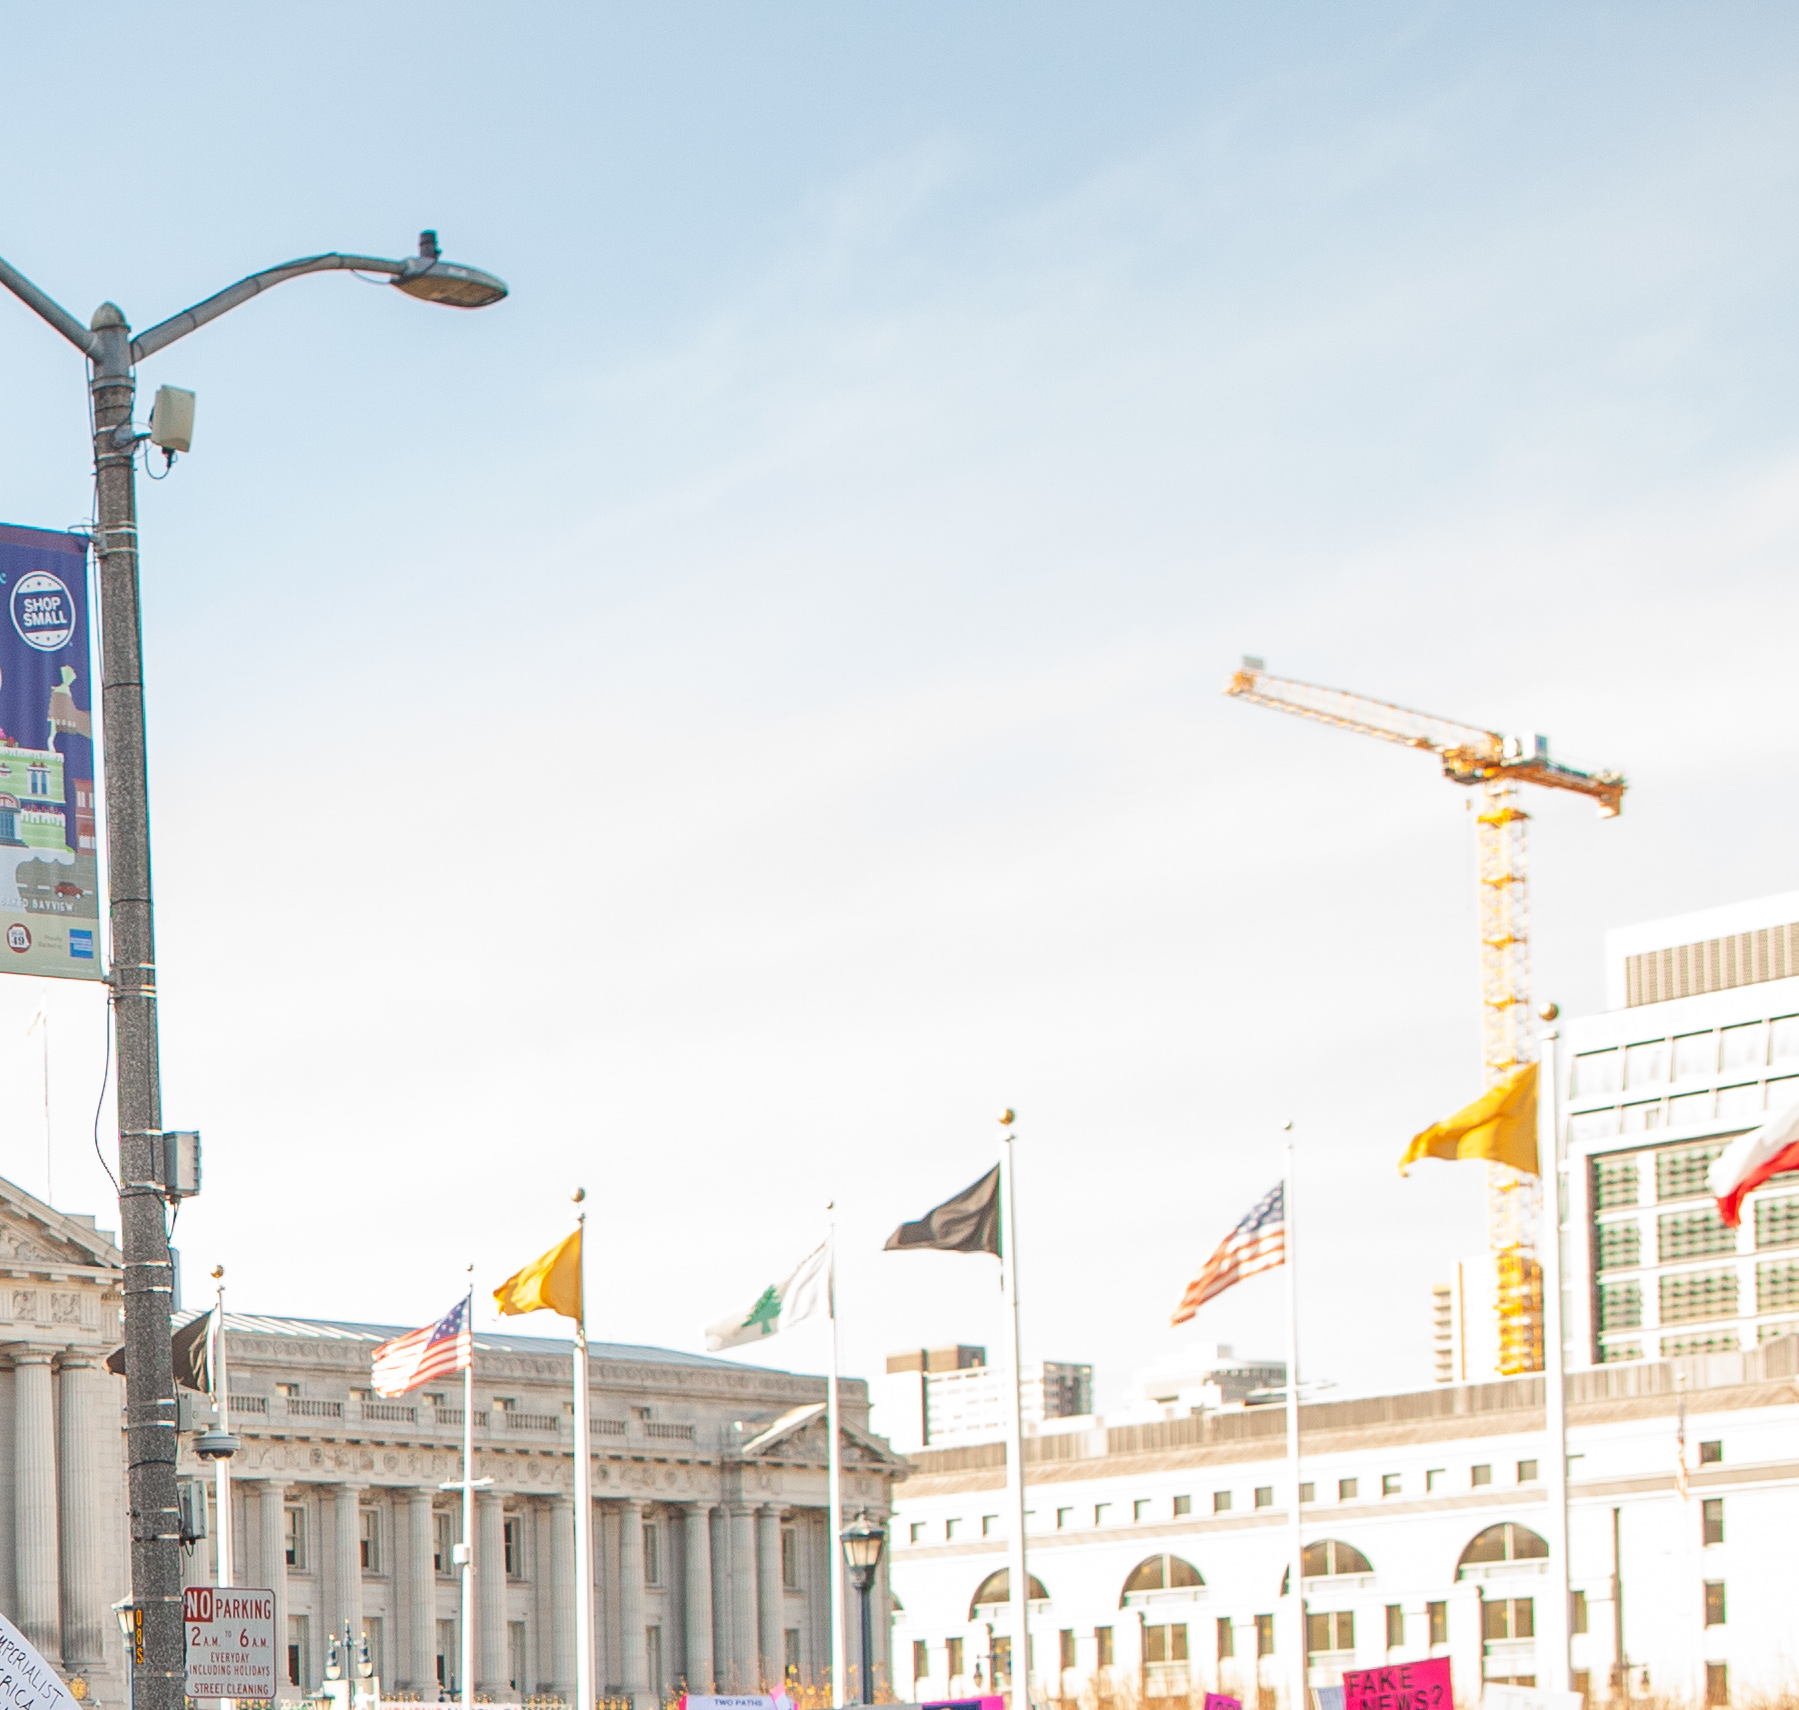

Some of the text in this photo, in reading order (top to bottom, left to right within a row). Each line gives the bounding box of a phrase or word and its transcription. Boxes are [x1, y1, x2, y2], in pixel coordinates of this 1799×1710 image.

[23, 596, 61, 613] SHOP
[23, 611, 68, 627] SMALL
[33, 899, 73, 912] BAYVIEW
[186, 1590, 271, 1620] NO PARKING
[191, 1626, 201, 1646] 2
[203, 1637, 221, 1647] A.M.
[239, 1628, 249, 1647] 6
[252, 1638, 269, 1648] A.M.
[210, 1652, 250, 1663] EVERYDAY
[189, 1664, 270, 1677] INCLUDING HOLIDAYS
[1348, 1666, 1415, 1697] FAKE
[194, 1683, 269, 1695] STREET CLEANING
[735, 1699, 763, 1707] PATHS
